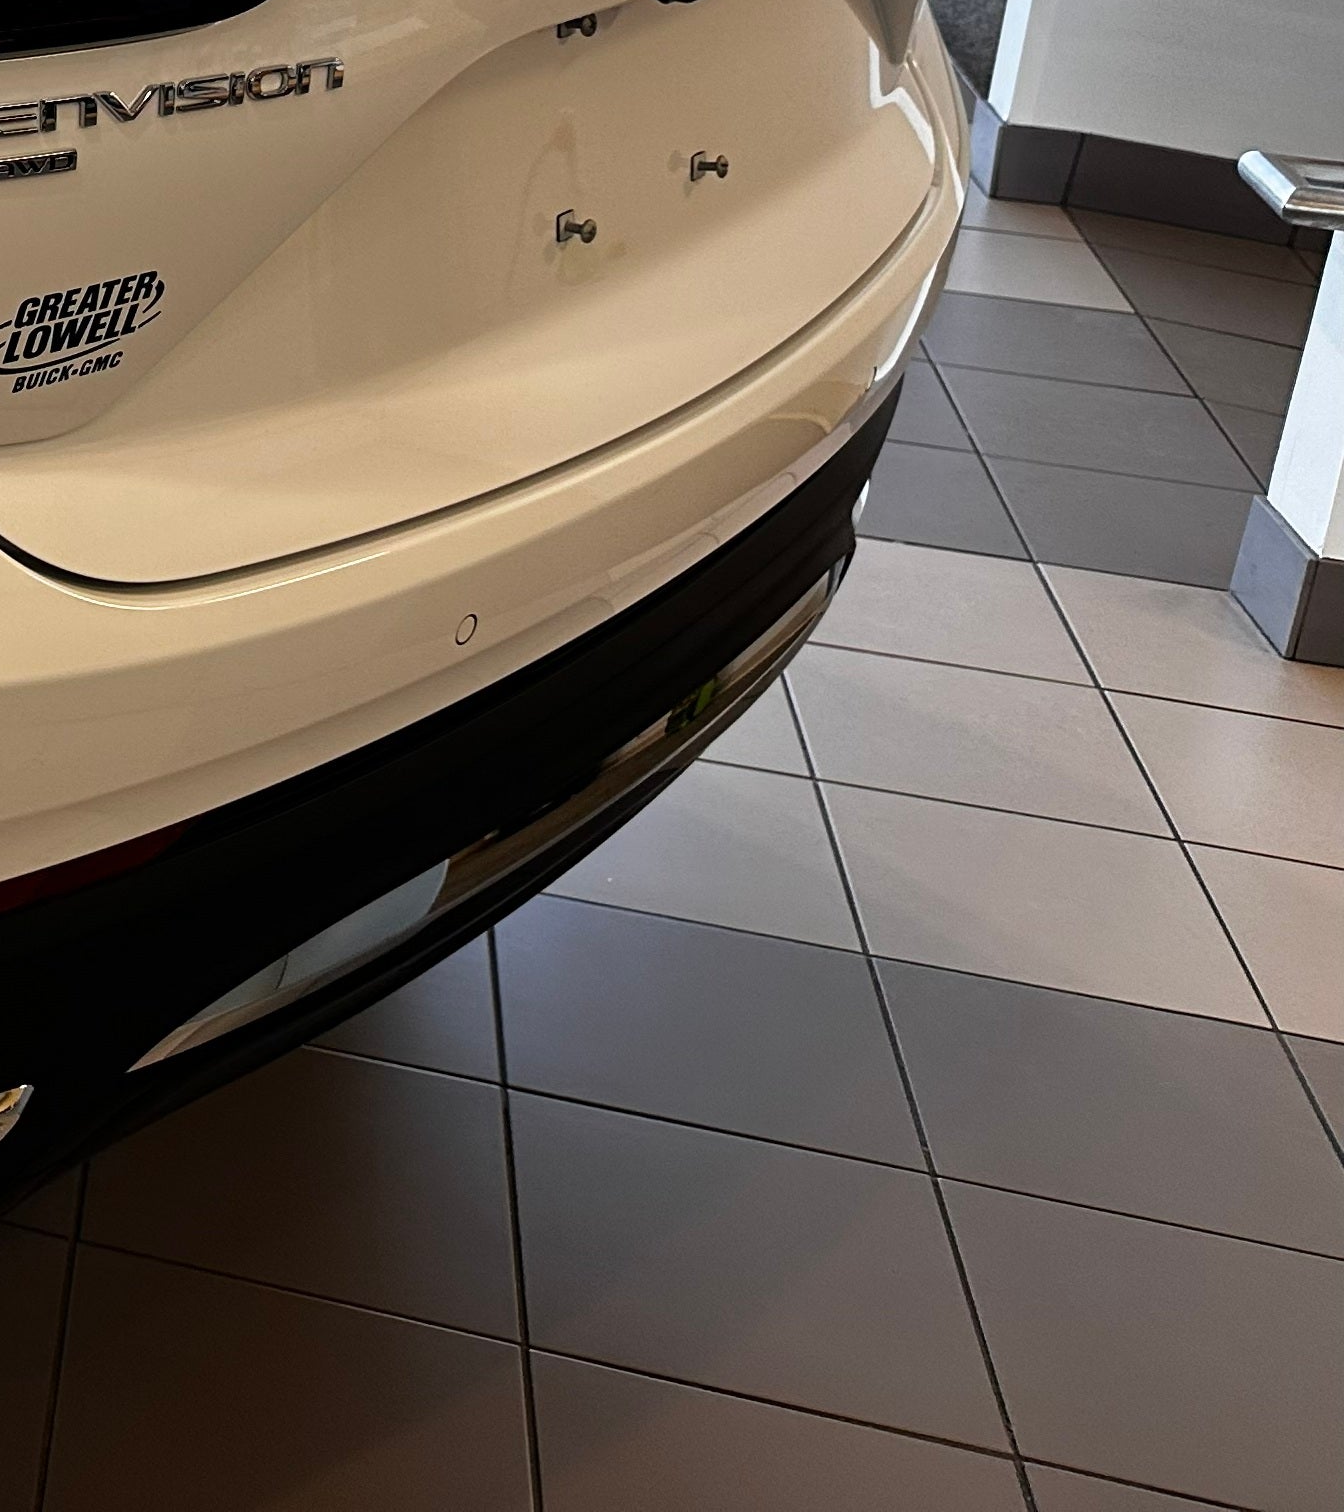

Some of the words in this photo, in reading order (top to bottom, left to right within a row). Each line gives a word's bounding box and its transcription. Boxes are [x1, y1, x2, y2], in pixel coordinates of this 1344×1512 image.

[14, 271, 158, 329] GREATER
[2, 303, 140, 365] LOWELL
[12, 350, 123, 394] BUICK-GMC
